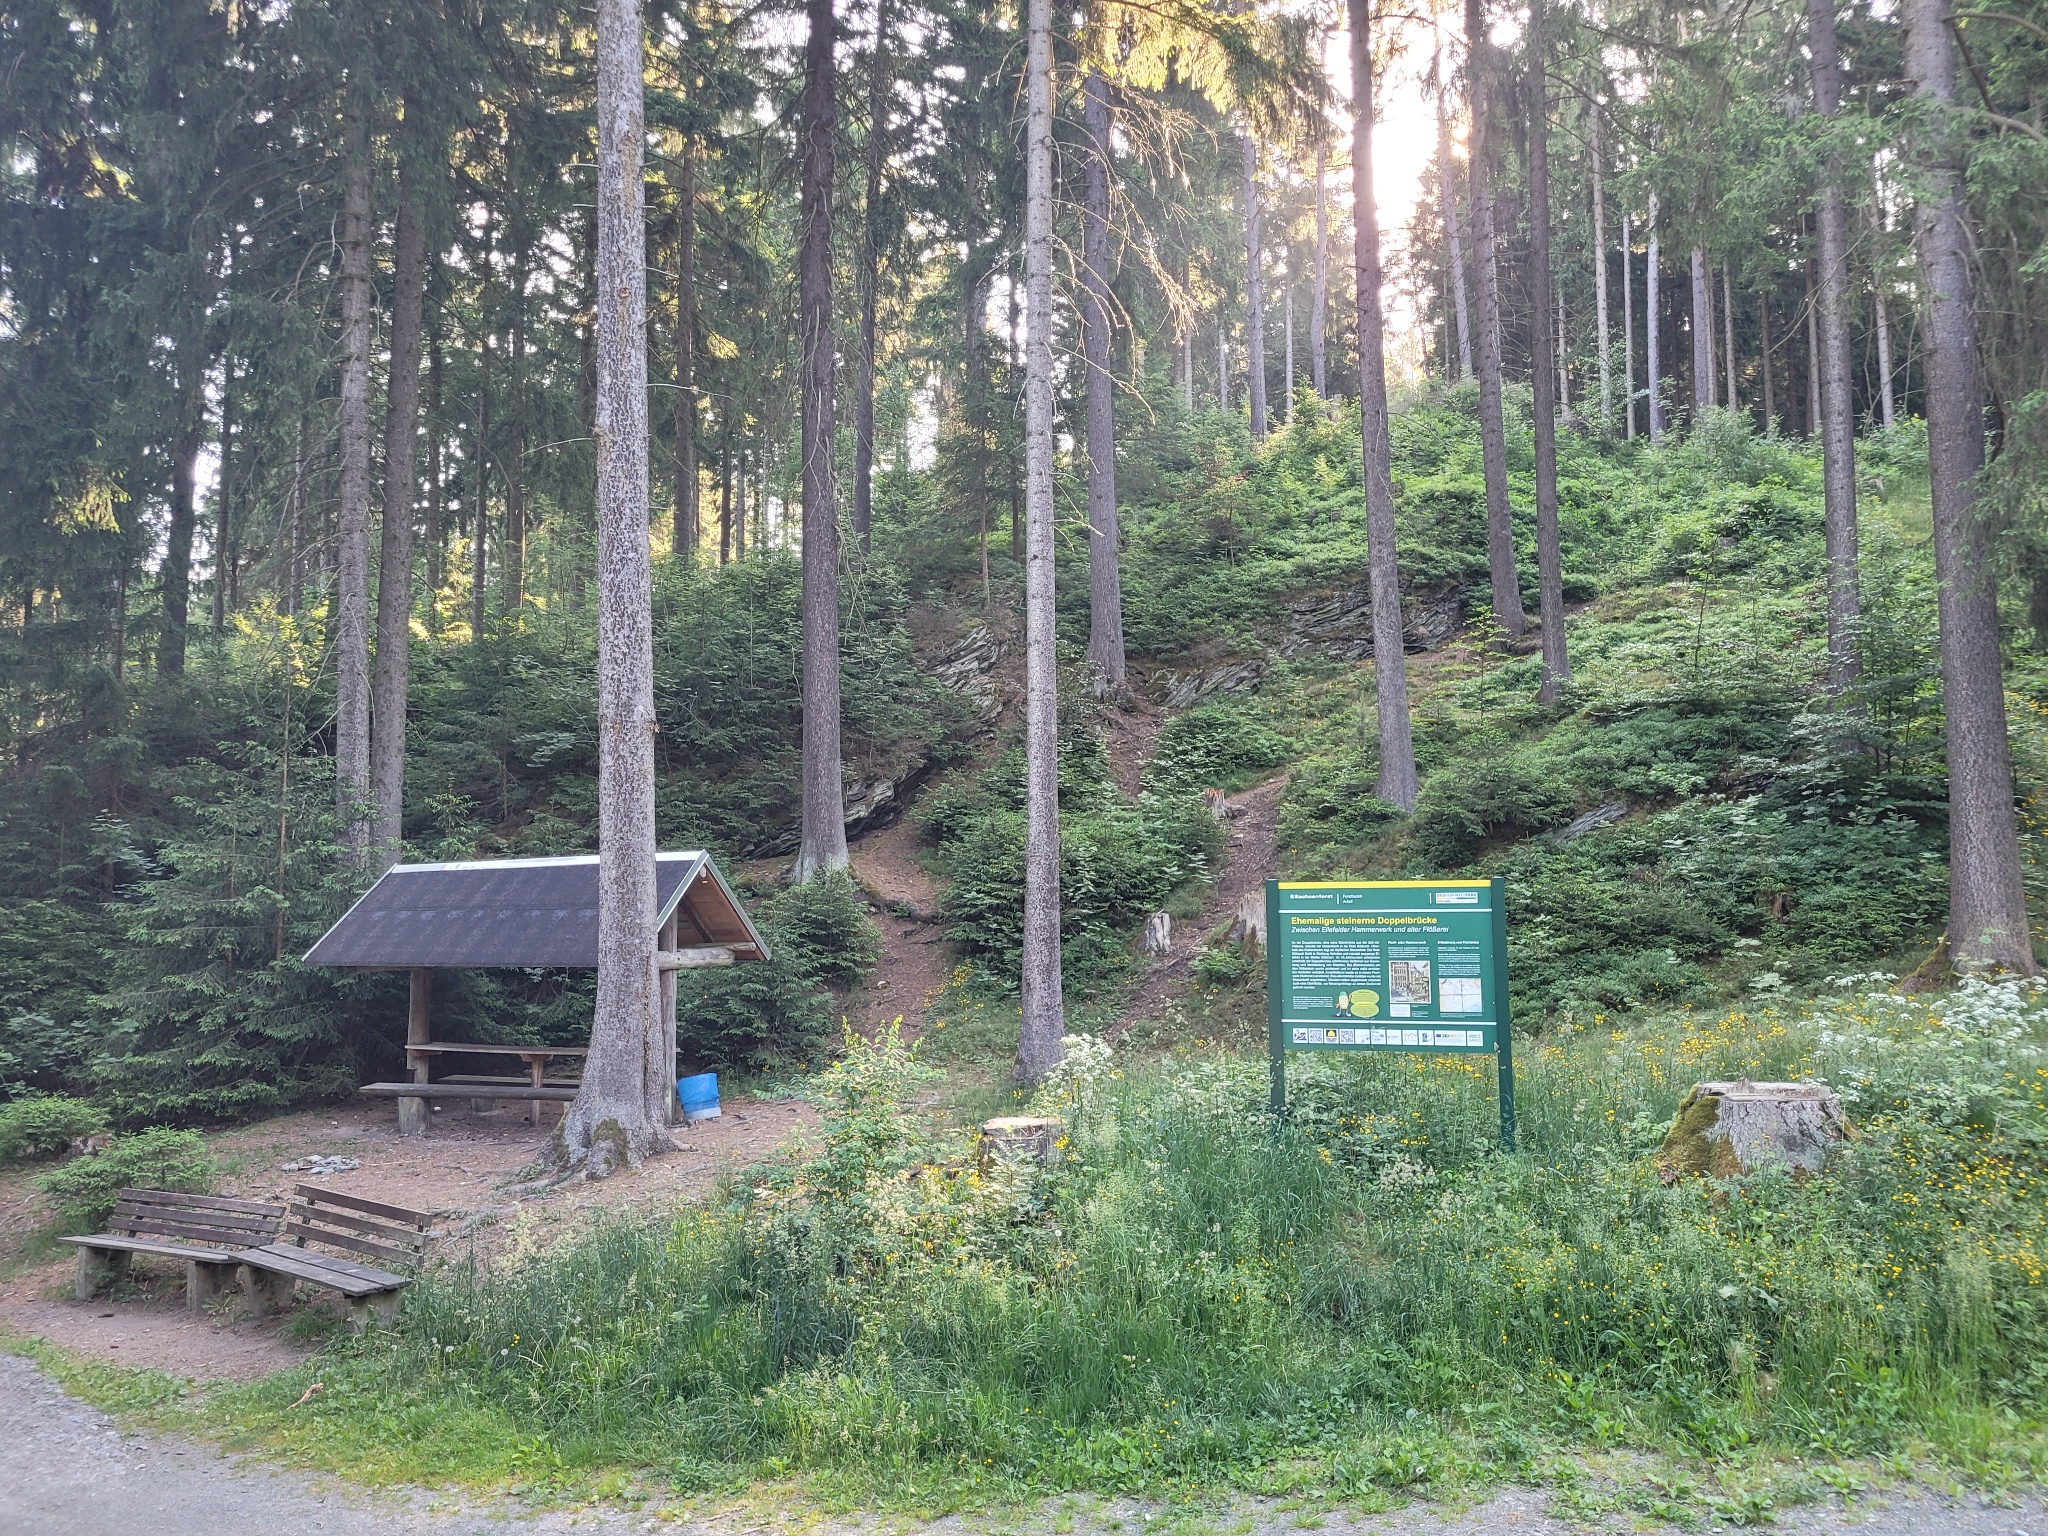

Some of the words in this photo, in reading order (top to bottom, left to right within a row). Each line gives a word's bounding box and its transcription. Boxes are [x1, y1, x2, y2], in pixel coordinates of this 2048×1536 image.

[1291, 917, 1334, 926] Ehemalige
[1337, 917, 1375, 925] steinerne
[1378, 916, 1437, 926] Doppelbrücke
